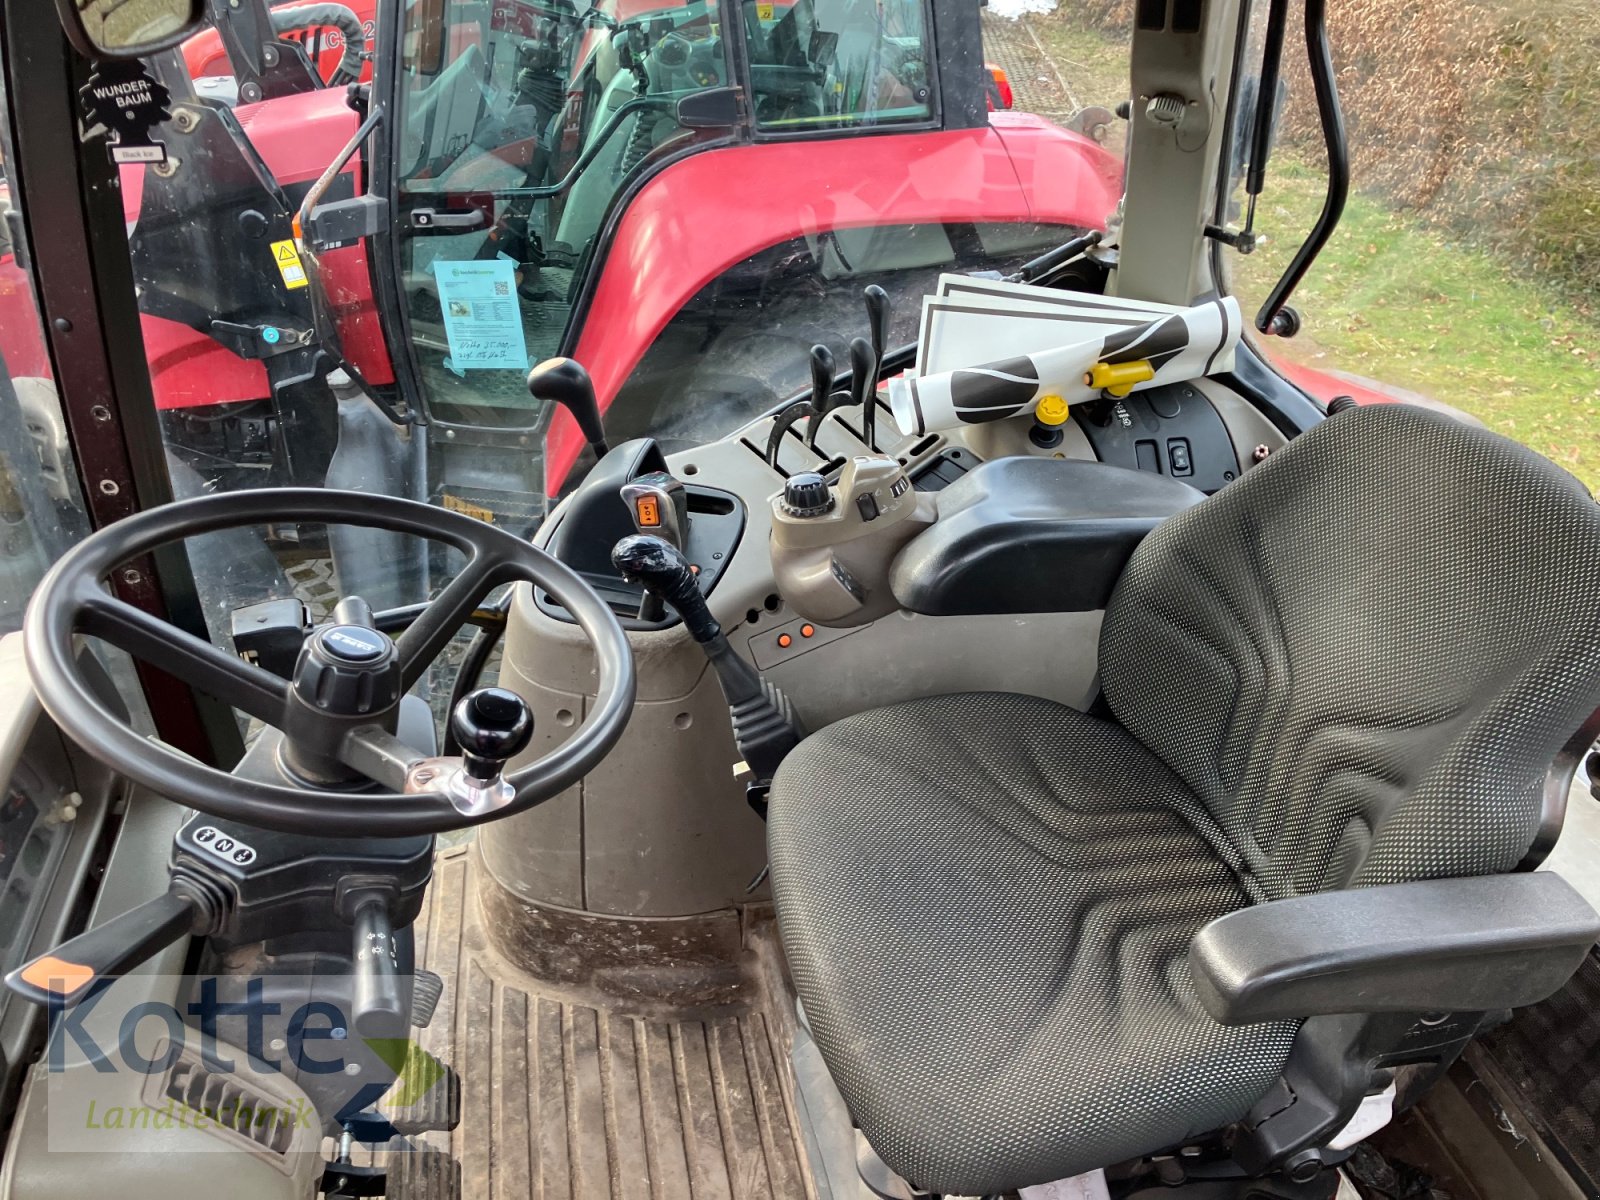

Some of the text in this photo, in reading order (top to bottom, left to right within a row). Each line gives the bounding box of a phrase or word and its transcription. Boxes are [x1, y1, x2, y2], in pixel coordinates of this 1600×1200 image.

[93, 80, 152, 99] WUNDER-
[116, 92, 152, 108] BAUM
[216, 840, 232, 851] N
